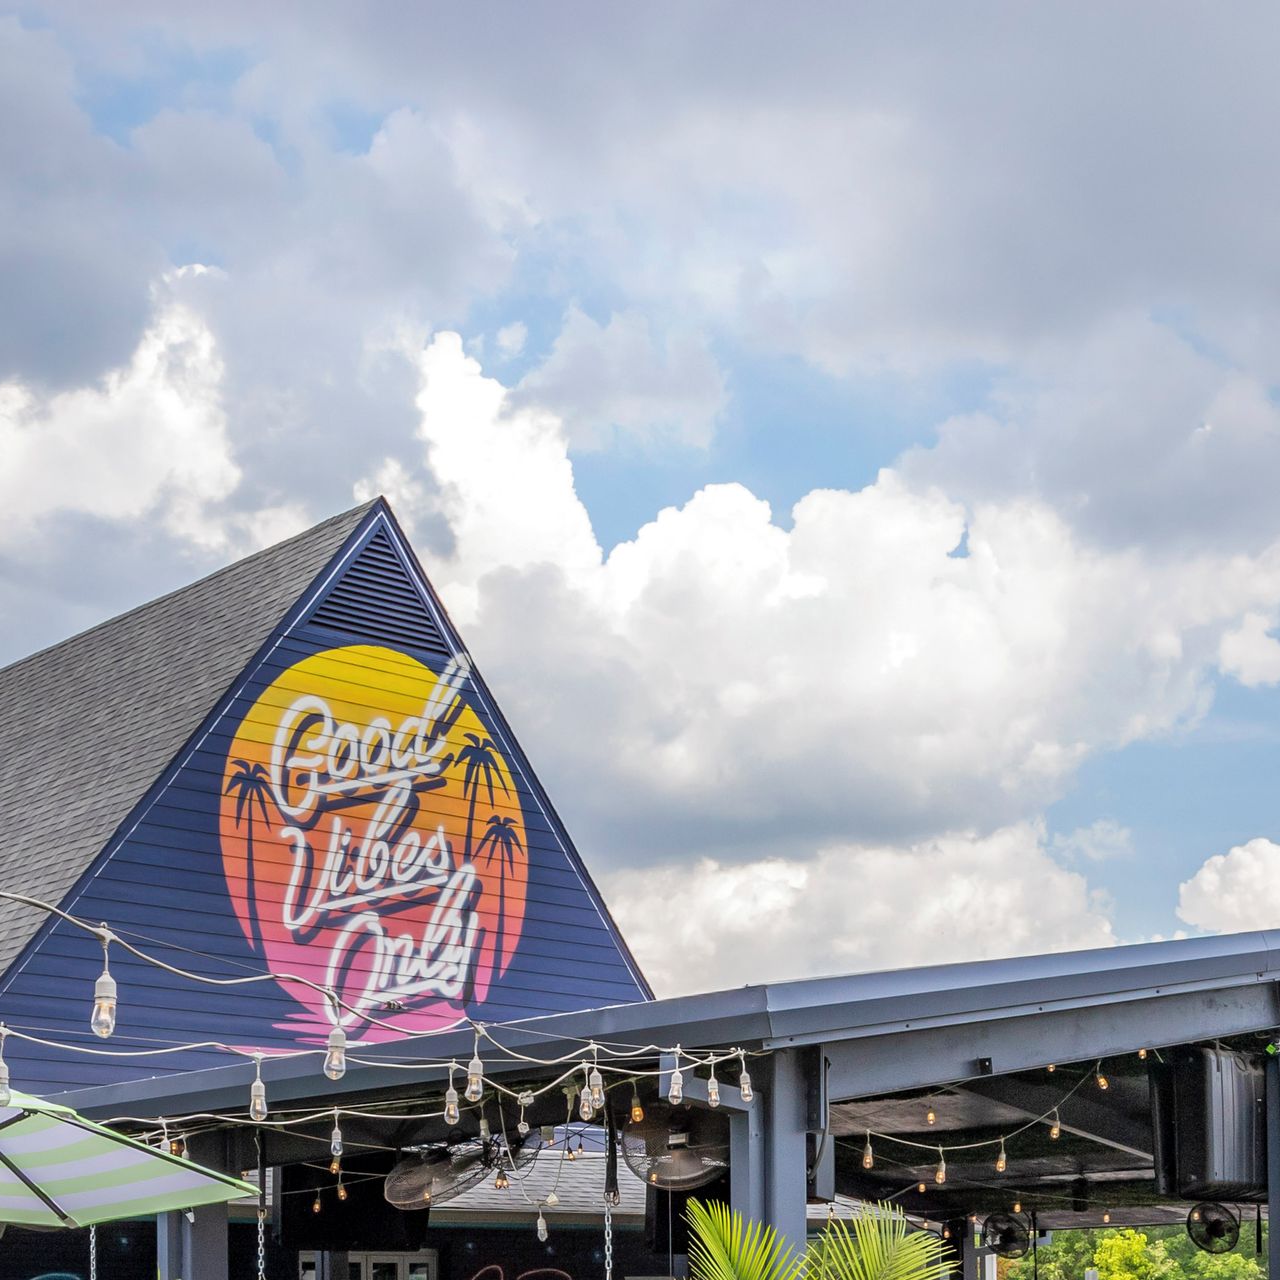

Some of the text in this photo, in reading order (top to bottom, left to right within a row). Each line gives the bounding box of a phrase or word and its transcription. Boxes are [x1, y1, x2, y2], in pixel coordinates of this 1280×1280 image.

[271, 653, 470, 816] Good
[280, 780, 450, 930] Vibes
[323, 863, 479, 1026] Only
